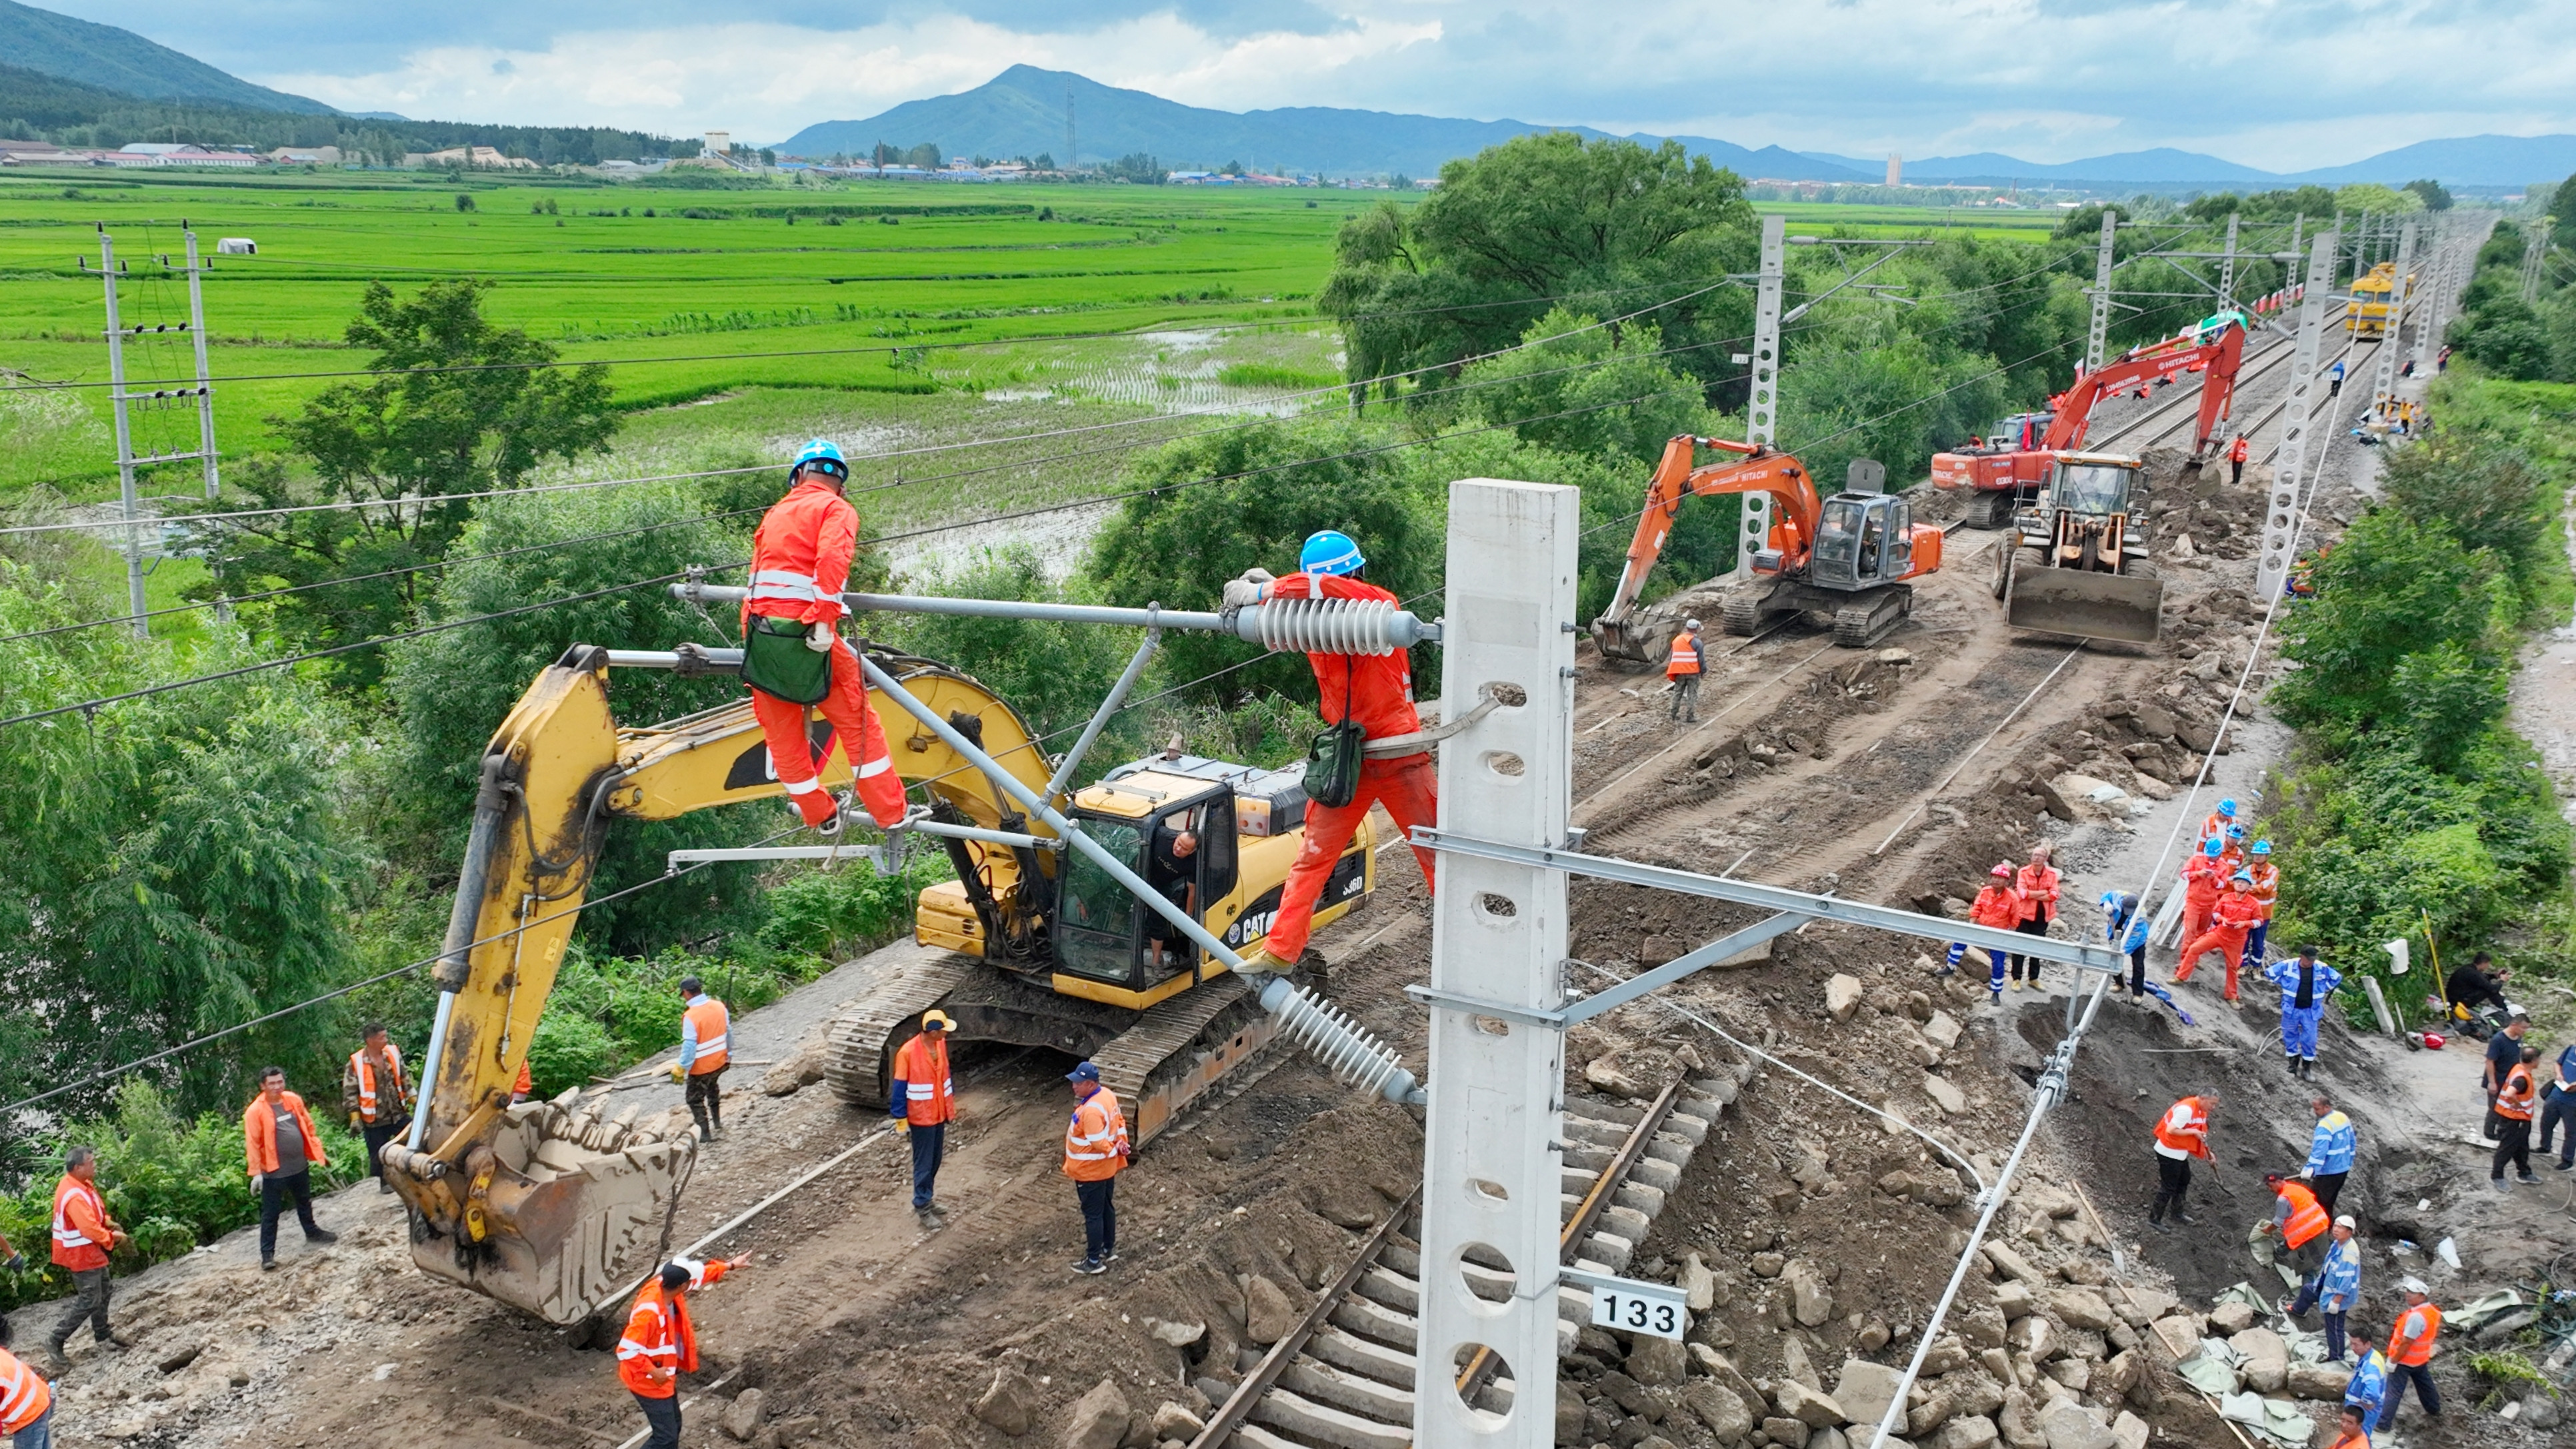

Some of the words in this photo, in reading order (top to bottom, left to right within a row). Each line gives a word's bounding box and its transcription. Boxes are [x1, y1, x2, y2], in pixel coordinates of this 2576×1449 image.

[2165, 353, 2200, 369] HITACHI
[1741, 470, 1768, 482] HITACHI
[1243, 912, 1266, 944] CAT
[1603, 1295, 1675, 1333] 133
